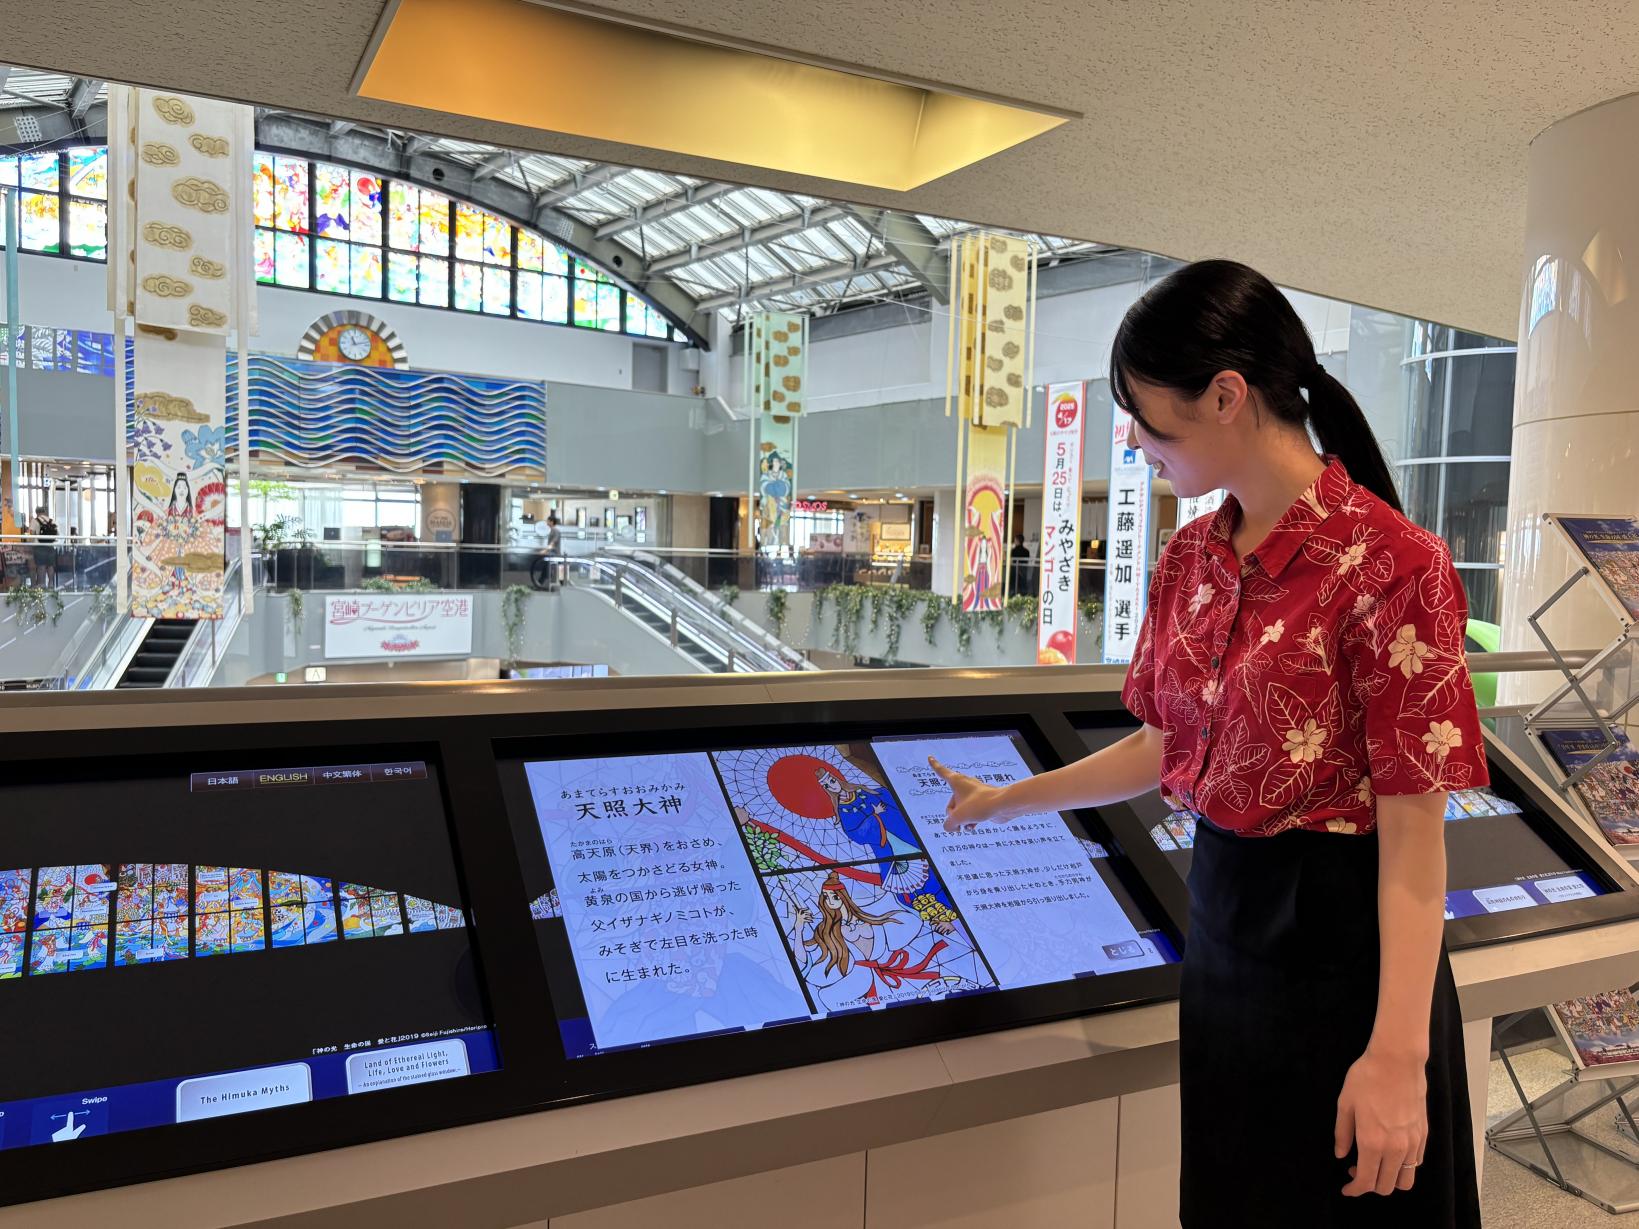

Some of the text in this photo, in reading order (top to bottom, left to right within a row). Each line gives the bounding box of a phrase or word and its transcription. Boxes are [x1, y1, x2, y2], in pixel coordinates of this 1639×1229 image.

[1114, 489, 1135, 584] 工藤遥加
[1059, 519, 1074, 592] みやざき
[1043, 525, 1056, 625] マンゴーの日
[331, 598, 468, 618] 宮崎ブーゲンビリア空港
[1114, 599, 1131, 641] 選手
[207, 776, 239, 786] 日本語
[259, 773, 308, 783] ENGLISH
[384, 766, 413, 776] 한국어
[561, 783, 686, 799] あまてらすおおみかみ
[575, 795, 682, 820] 天照大神
[577, 859, 726, 884] 太陽をつかさどる女神。
[584, 880, 742, 907] 黄泉の国から逃げ帰った
[591, 904, 734, 932] 父イザナギノミコトが、
[599, 926, 759, 957] みそぎで左目を洗った時
[606, 962, 690, 984] に生まれた。
[364, 1050, 448, 1069] Land of Ethereal Light,
[368, 1058, 449, 1077] Life, Love and Flowers
[81, 1095, 108, 1105] Swipe
[200, 1083, 290, 1104] The Himuka Myths
